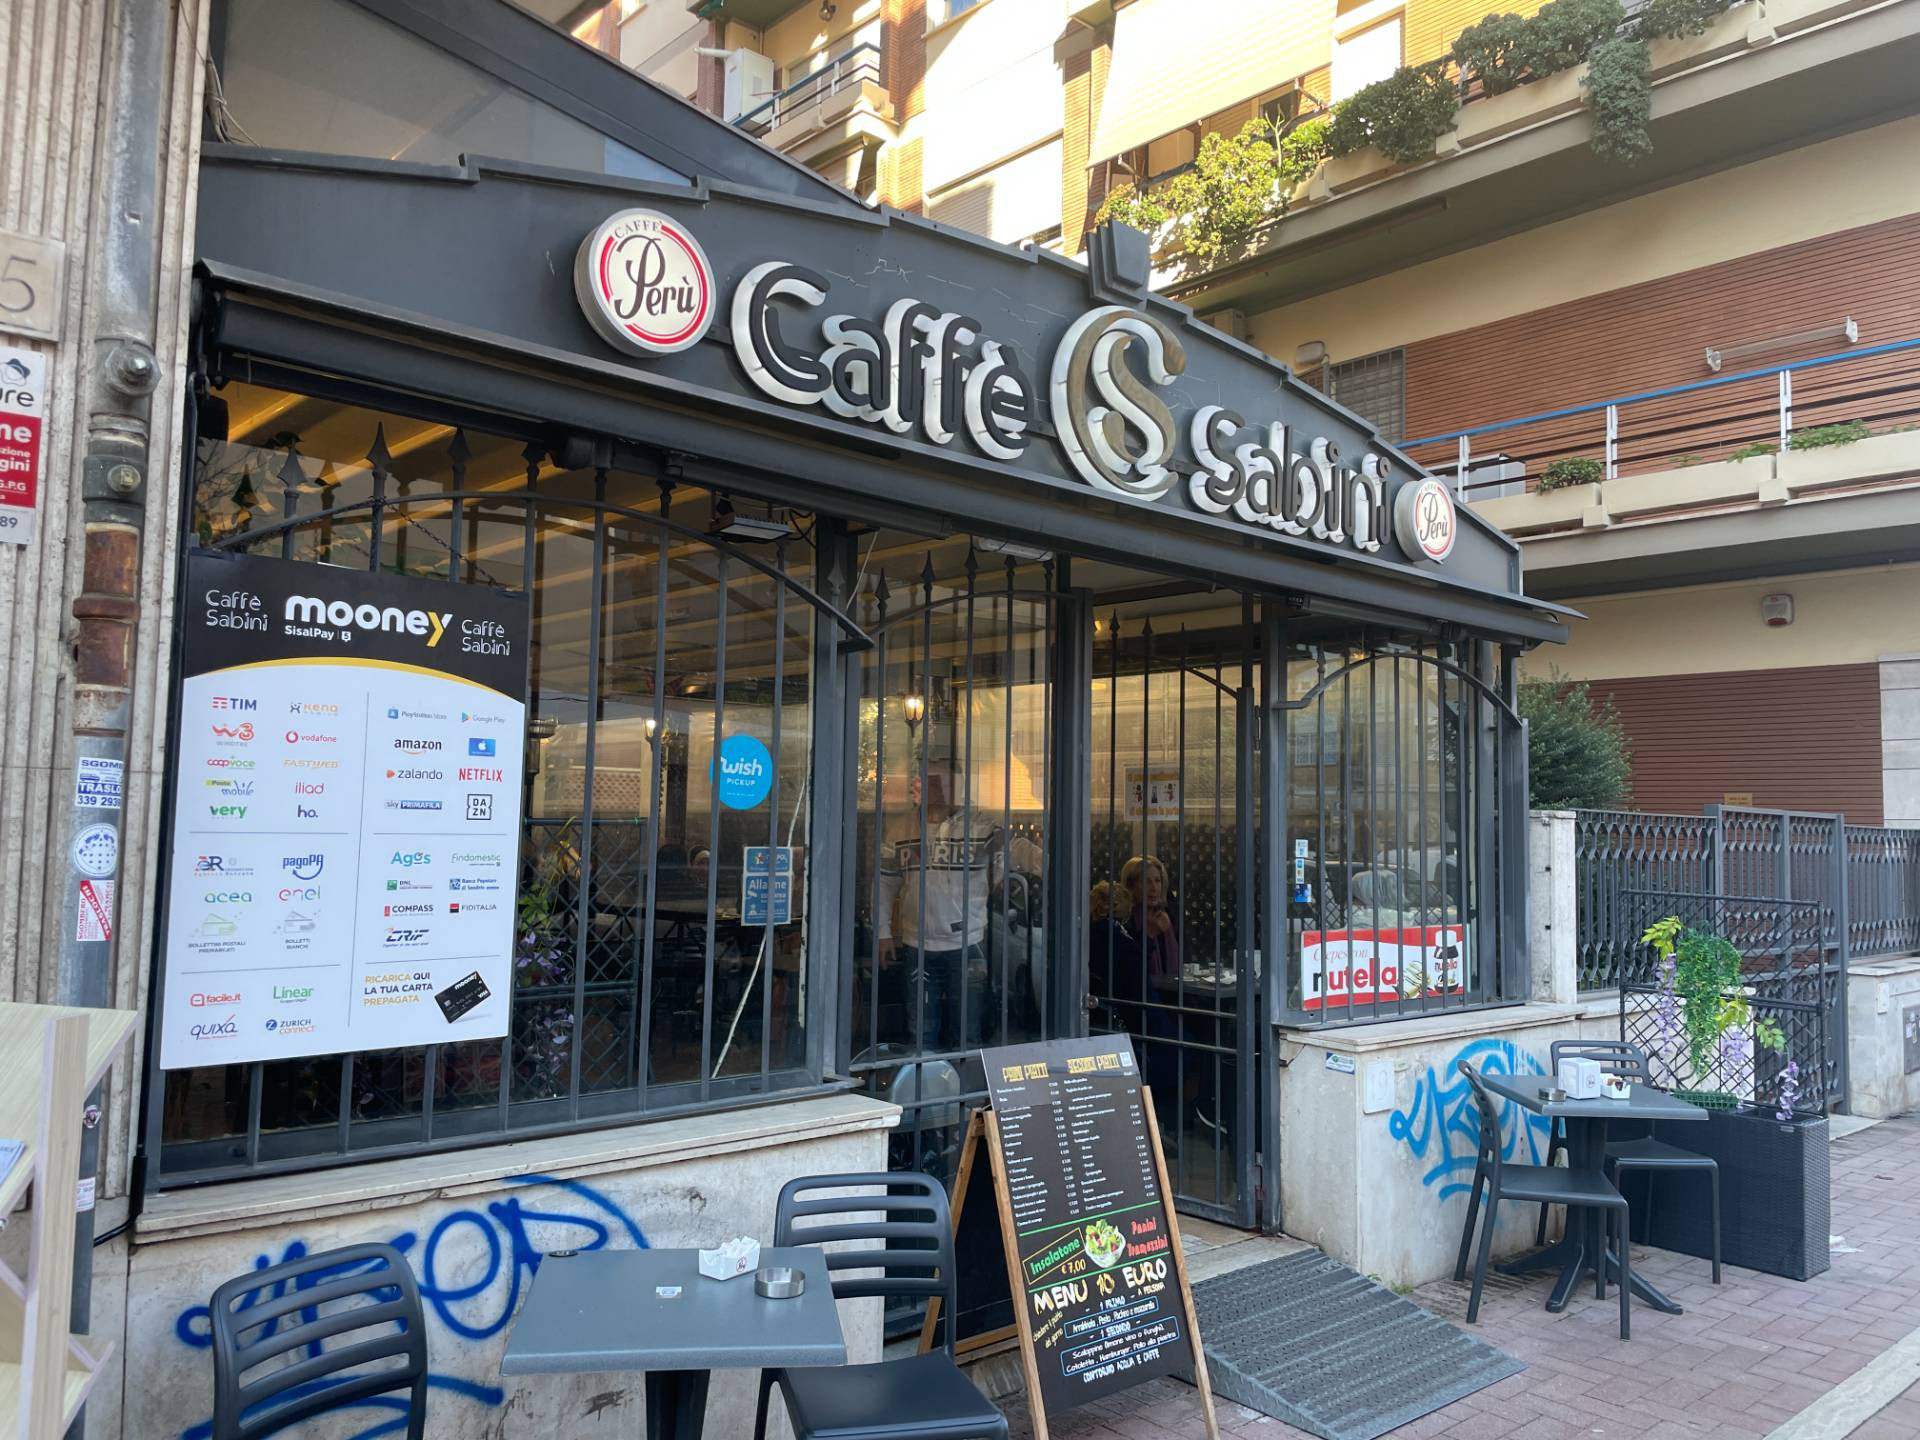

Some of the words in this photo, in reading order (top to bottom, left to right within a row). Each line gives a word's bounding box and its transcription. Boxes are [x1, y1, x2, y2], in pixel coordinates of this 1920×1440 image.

[614, 234, 696, 320] Perù
[731, 260, 1032, 460] Caffè
[1190, 405, 1393, 553] Sabini
[1420, 491, 1448, 542] Perù
[206, 589, 262, 611] Caffè
[206, 609, 269, 632] Sabini
[285, 595, 453, 647] mooney
[284, 624, 335, 641] SisalPay
[461, 619, 505, 639] Caffè
[461, 637, 511, 656] Sabini
[230, 698, 257, 711] TIM
[300, 732, 337, 743] vodafone
[394, 737, 442, 751] amazon
[397, 768, 443, 781] zalando
[459, 767, 503, 783] NETFLIX
[726, 777, 756, 787] PICKUP
[295, 782, 325, 796] iliad
[209, 805, 248, 820] very
[281, 853, 325, 870] pagoPA
[204, 891, 253, 904] acea
[391, 904, 434, 914] COMPASS
[461, 903, 497, 912] FIDITALIA
[364, 974, 411, 984] RICARICA
[412, 971, 431, 981] QUI
[273, 985, 315, 1000] Linear
[364, 986, 377, 995] LA
[380, 985, 399, 994] TUA
[401, 982, 434, 993] CARTA
[363, 994, 420, 1006] PREPAGATA
[1131, 1216, 1157, 1236] Panini
[1030, 1237, 1081, 1276] Insalatone
[1033, 1279, 1089, 1315] MENU
[1096, 1272, 1116, 1297] 10
[1122, 1257, 1167, 1288] EURO
